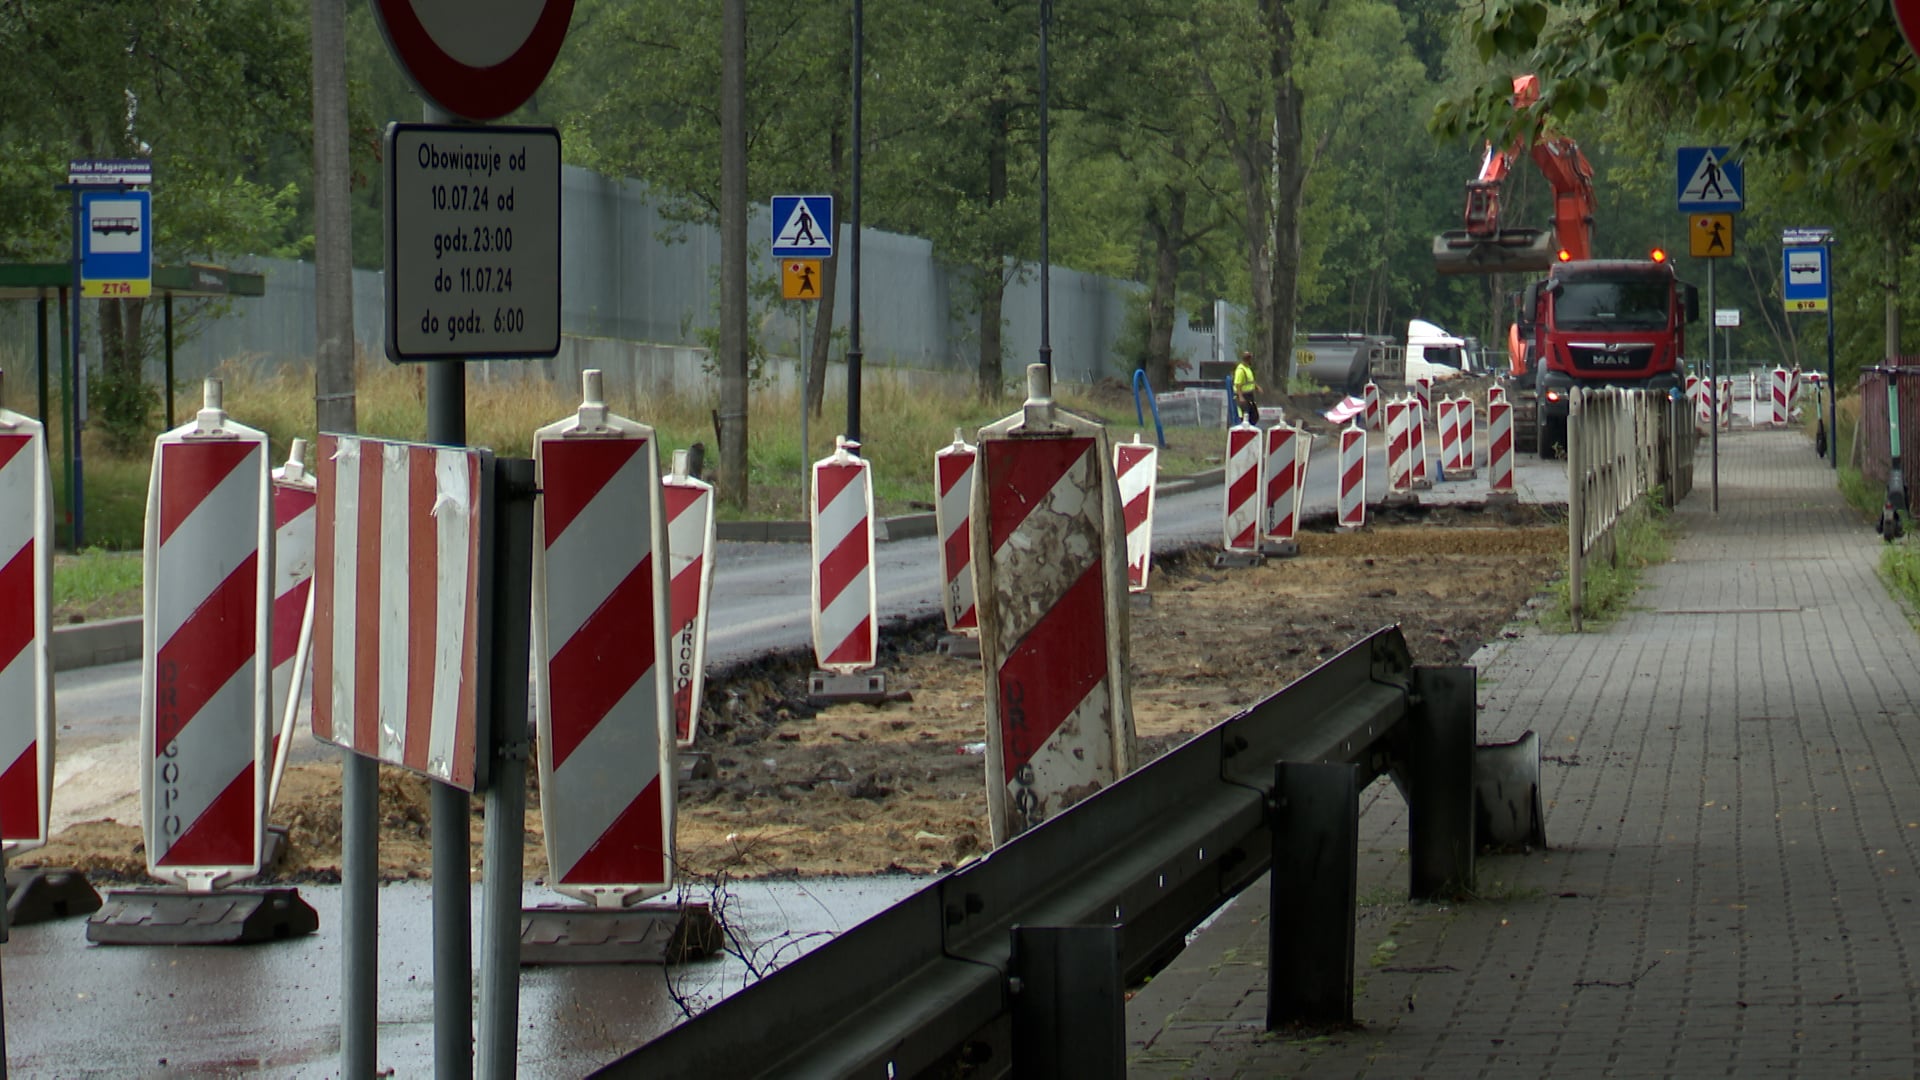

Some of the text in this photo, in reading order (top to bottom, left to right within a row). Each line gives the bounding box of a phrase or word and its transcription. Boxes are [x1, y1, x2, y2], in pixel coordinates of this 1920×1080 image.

[70, 162, 92, 171] Ruda
[418, 143, 526, 177] Obowiązuje od
[432, 185, 514, 212] 10.07.24 od
[434, 227, 513, 260] godz.23:00
[102, 282, 130, 295] ZTM
[434, 267, 513, 292] do 11.07.24
[421, 307, 524, 341] do godz. 6:00
[1592, 355, 1630, 365] MAN
